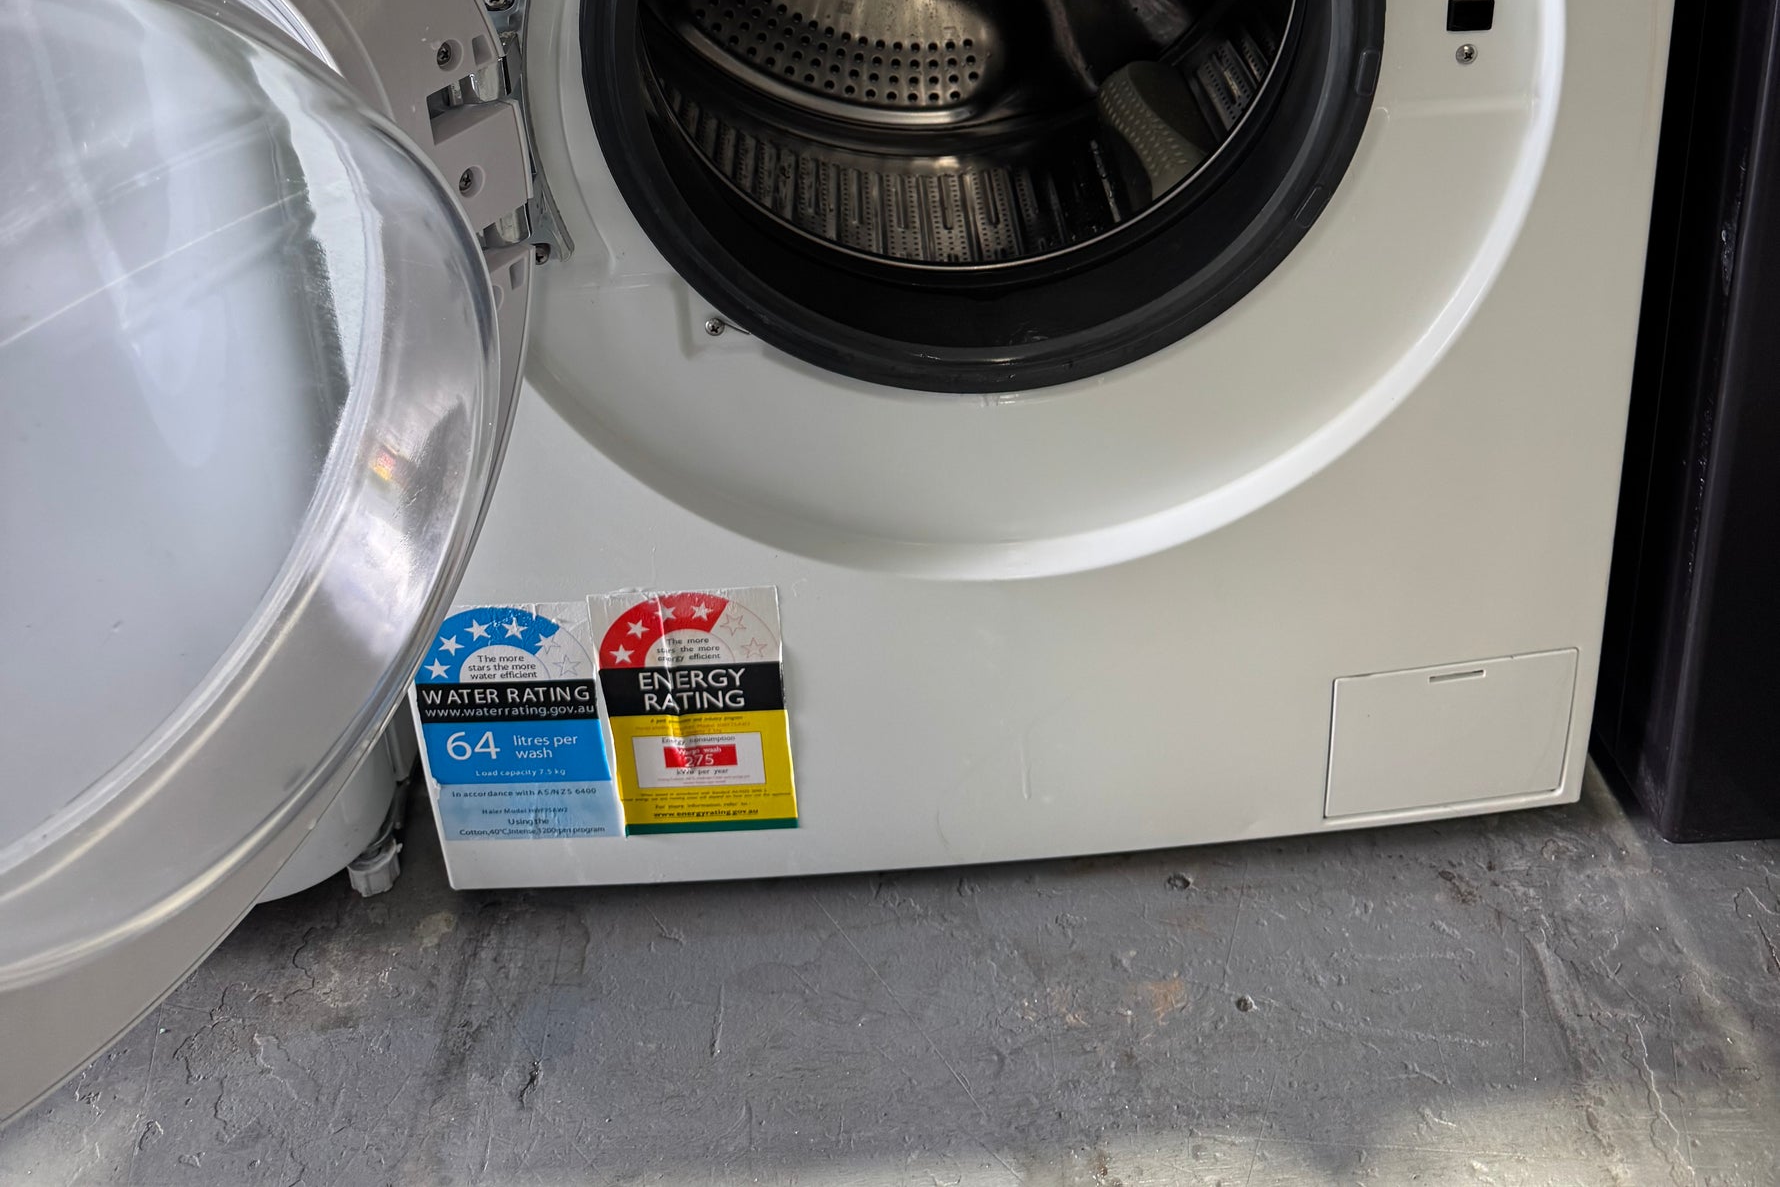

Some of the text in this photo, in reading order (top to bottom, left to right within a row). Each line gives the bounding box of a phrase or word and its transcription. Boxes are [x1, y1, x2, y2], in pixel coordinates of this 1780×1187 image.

[477, 655, 496, 663] The
[658, 655, 685, 663] energy
[468, 664, 491, 672] stars
[493, 663, 509, 671] the
[500, 671, 538, 679] efficient
[638, 668, 746, 691] ENERGY
[422, 685, 590, 705] WATER RATING
[644, 689, 745, 713] RATING
[425, 704, 595, 718] www.waterrating.gov.au
[446, 730, 500, 761] 64
[513, 734, 578, 748] litres per
[516, 748, 553, 759] wash
[685, 754, 714, 767] 275
[500, 768, 537, 777] capacity
[554, 768, 566, 776] kg
[463, 790, 513, 798] accordance
[575, 787, 597, 795] 6400
[508, 817, 549, 826] Using the
[573, 826, 605, 835] program
